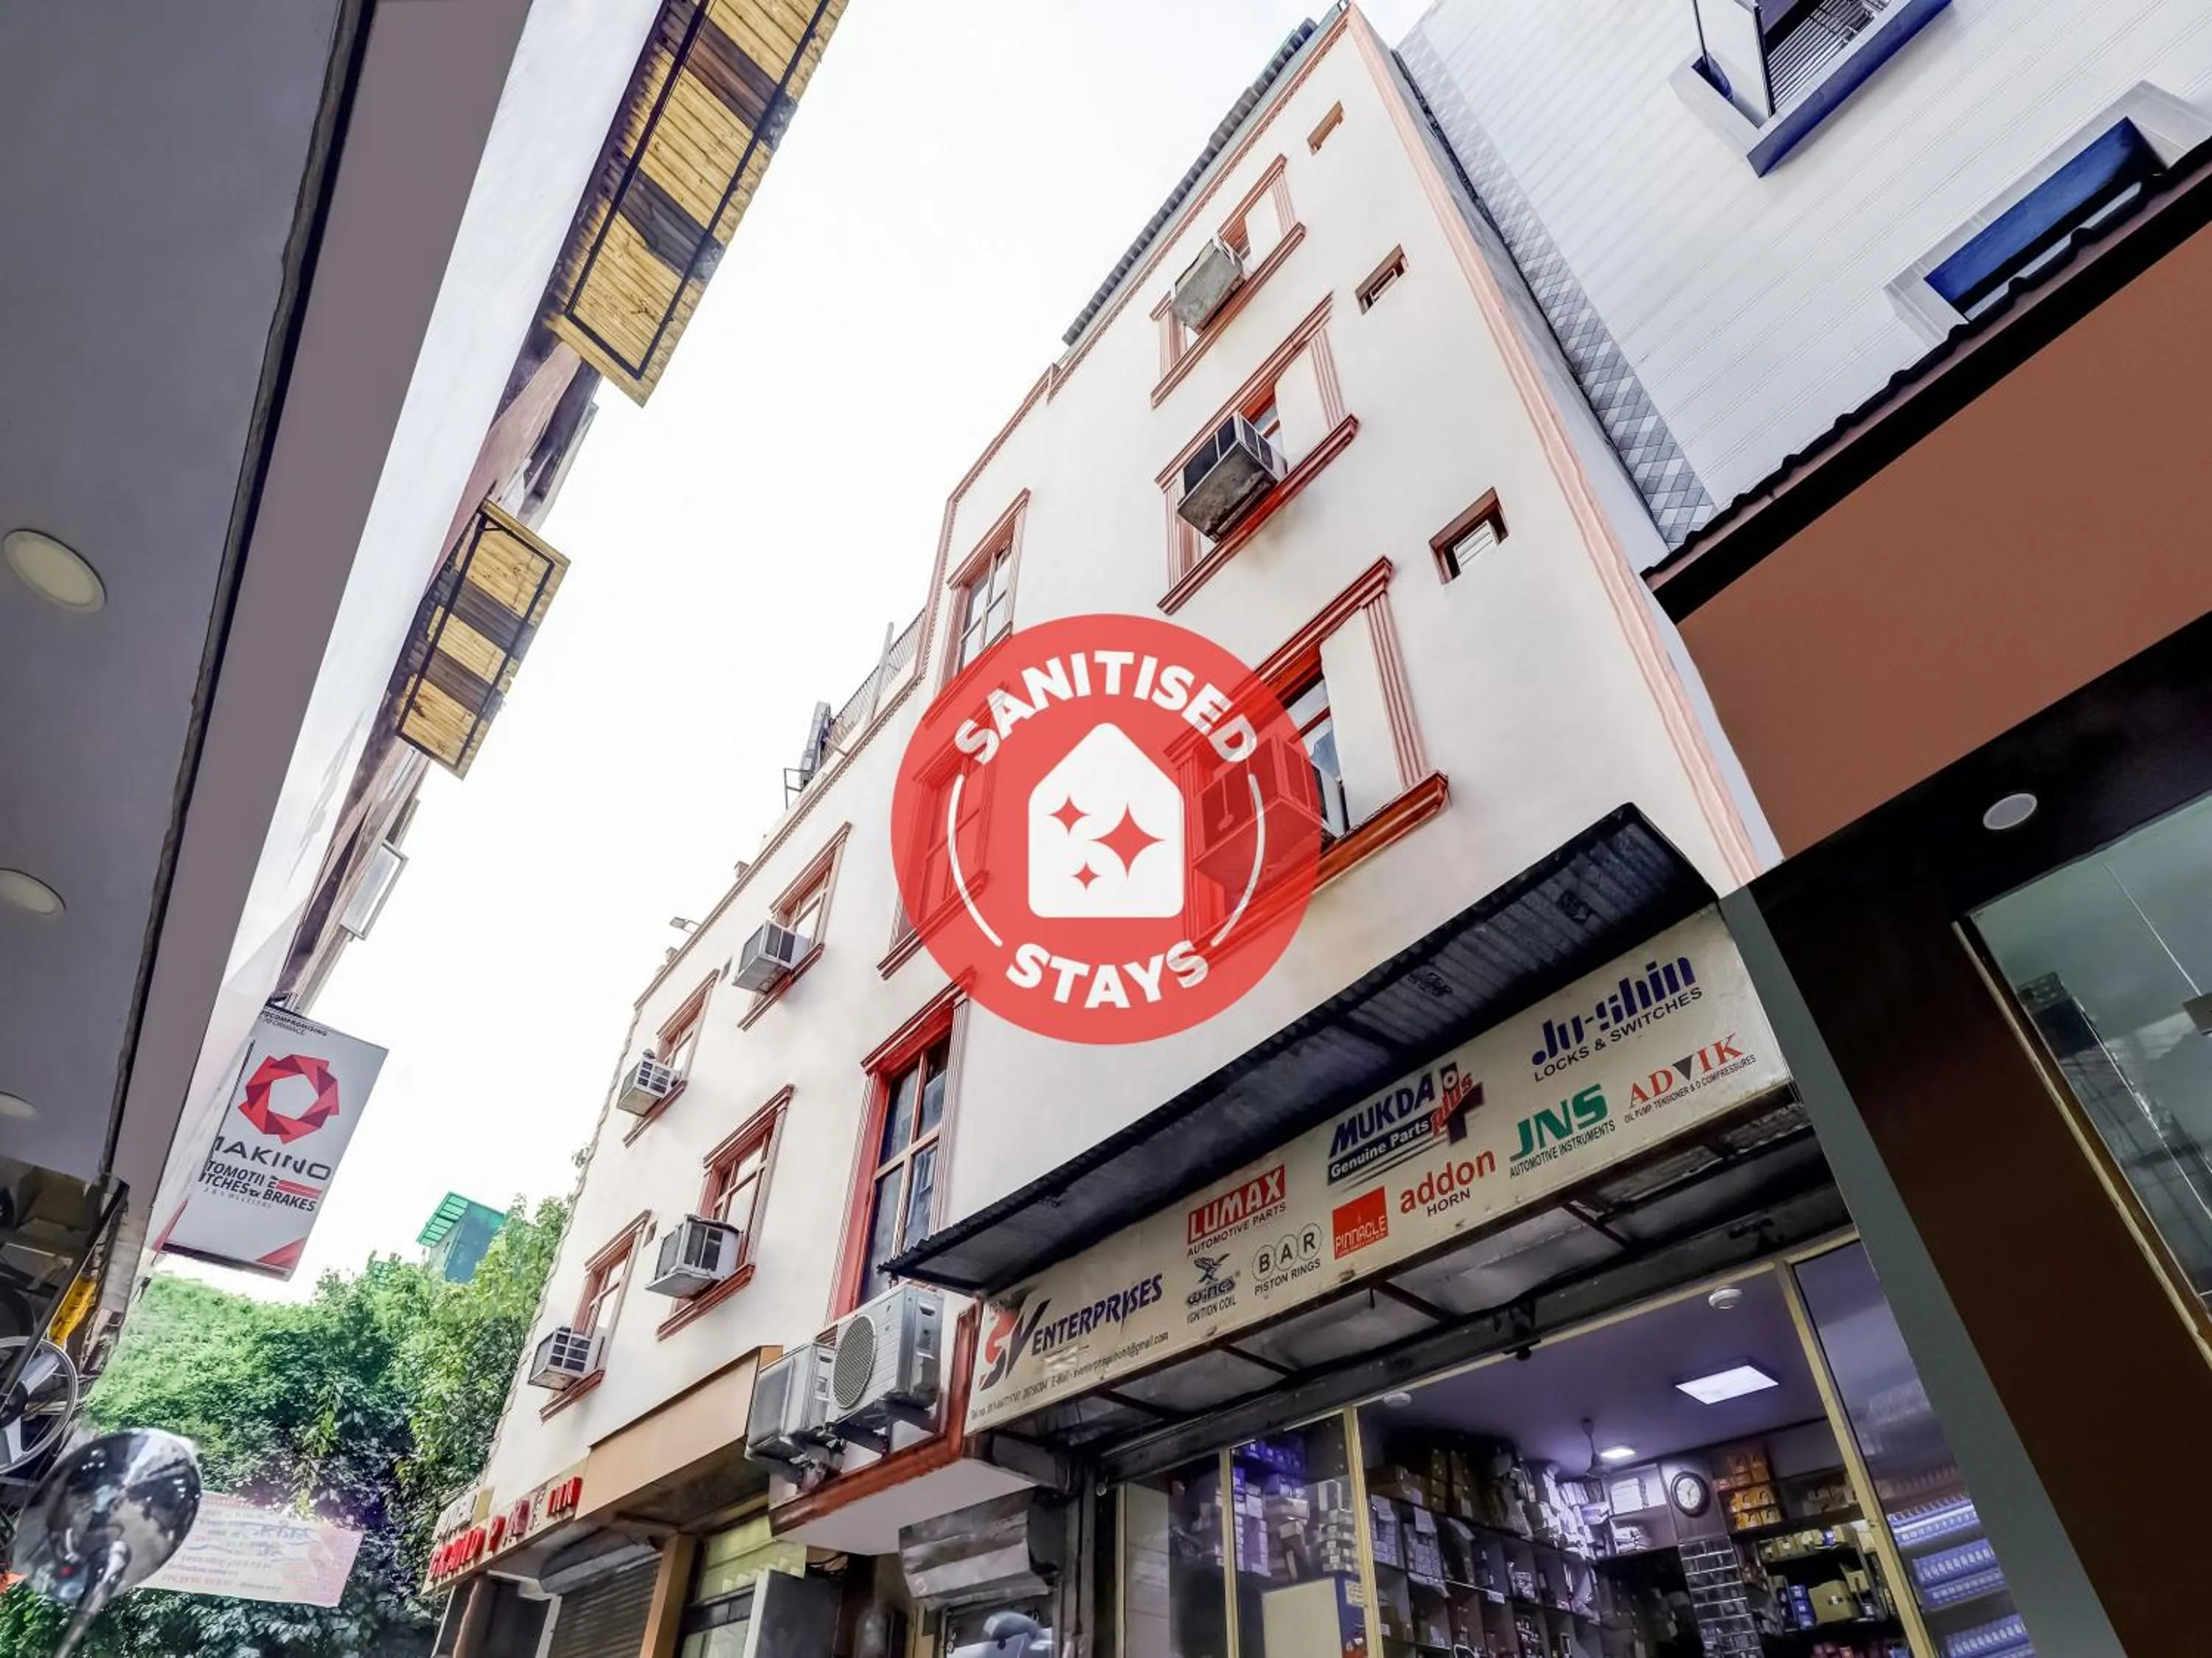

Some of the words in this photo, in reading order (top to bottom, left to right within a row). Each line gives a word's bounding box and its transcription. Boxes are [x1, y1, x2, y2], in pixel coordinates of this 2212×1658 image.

[1534, 1047, 1589, 1082] LOCKS
[1595, 1038, 1606, 1051] &
[1611, 988, 1703, 1042] SWITCHES
[1329, 1072, 1436, 1159] MUKDA
[1510, 1083, 1608, 1163] JNS
[1331, 1143, 1387, 1178] Genuine
[1390, 1120, 1429, 1148] Parts
[1510, 1146, 1558, 1180] AUTOMOTIVE
[1558, 1119, 1615, 1154] INSTRUMENTS
[262, 1189, 317, 1212] BRAKES
[1190, 1169, 1281, 1241] LUMAX
[1400, 1151, 1495, 1214] addon
[1427, 1187, 1471, 1217] HORN
[1187, 1220, 1249, 1258] AUTOMOTIVE
[1253, 1202, 1286, 1225] PARTS
[1257, 1230, 1317, 1274] BAR
[1219, 1295, 1237, 1311] COIL
[1255, 1272, 1289, 1296] PISTON
[1291, 1258, 1321, 1280] RINGS
[1032, 1274, 1164, 1357] ENTERPRISES
